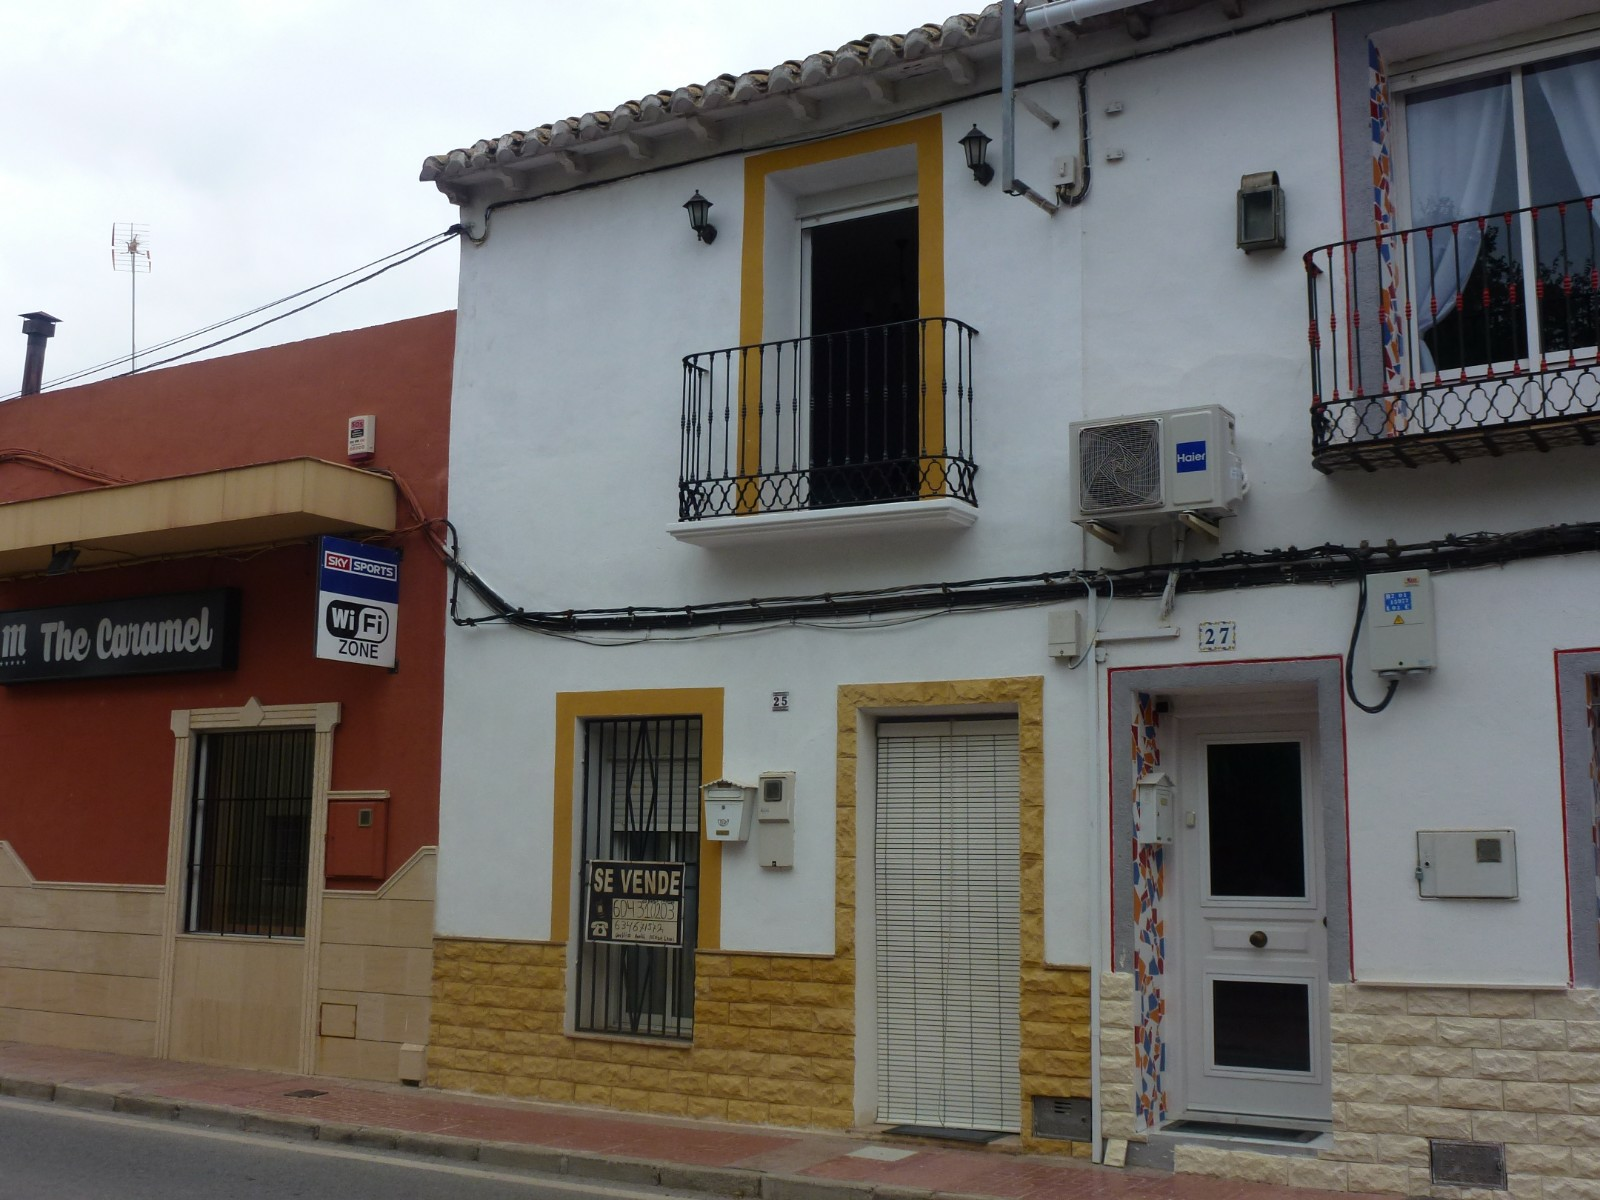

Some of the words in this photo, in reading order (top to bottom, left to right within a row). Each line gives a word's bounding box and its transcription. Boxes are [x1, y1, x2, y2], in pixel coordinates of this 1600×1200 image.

[1177, 452, 1206, 463] Haier
[328, 555, 349, 568] SKY
[353, 561, 394, 577] SPORTS
[40, 620, 91, 663] The
[96, 607, 214, 660] Caramel
[1205, 627, 1230, 645] 27
[338, 639, 379, 659] ZONE
[773, 696, 788, 707] 25
[593, 868, 614, 893] SE
[620, 869, 681, 896] VENDE
